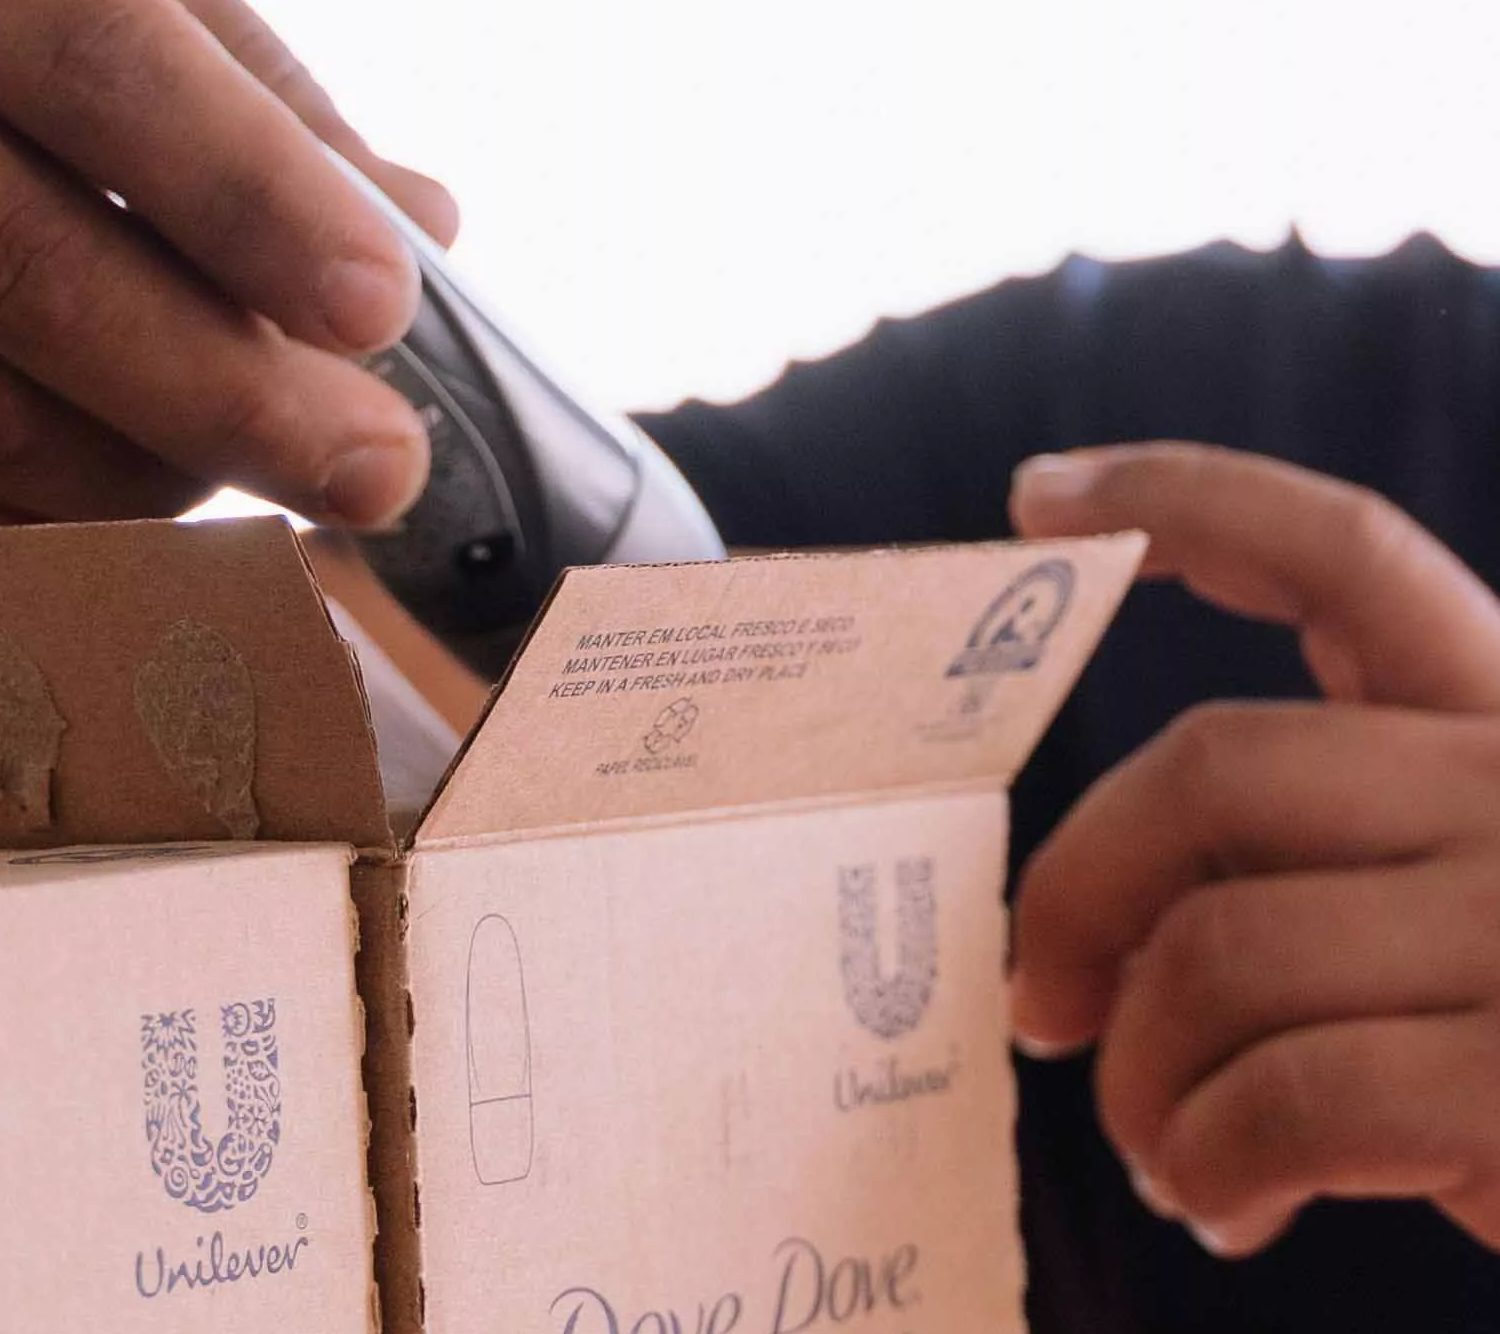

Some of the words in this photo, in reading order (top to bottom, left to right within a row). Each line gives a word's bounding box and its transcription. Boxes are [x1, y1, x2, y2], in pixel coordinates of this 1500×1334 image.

[575, 630, 647, 651] MANTER
[647, 628, 674, 646] EM
[675, 624, 728, 643] LOCAL
[731, 618, 797, 638] FRESCO
[562, 652, 654, 675] MANTENER
[656, 650, 682, 668] EN
[681, 645, 739, 665] LUGAR
[738, 641, 804, 660] FRESCO
[548, 680, 596, 699] KEEP
[596, 679, 615, 695] IN
[614, 677, 627, 692] A
[629, 672, 686, 691] FRESH
[684, 668, 720, 685] AND
[721, 666, 756, 684] DRY
[136, 1231, 309, 1299] Unilever
